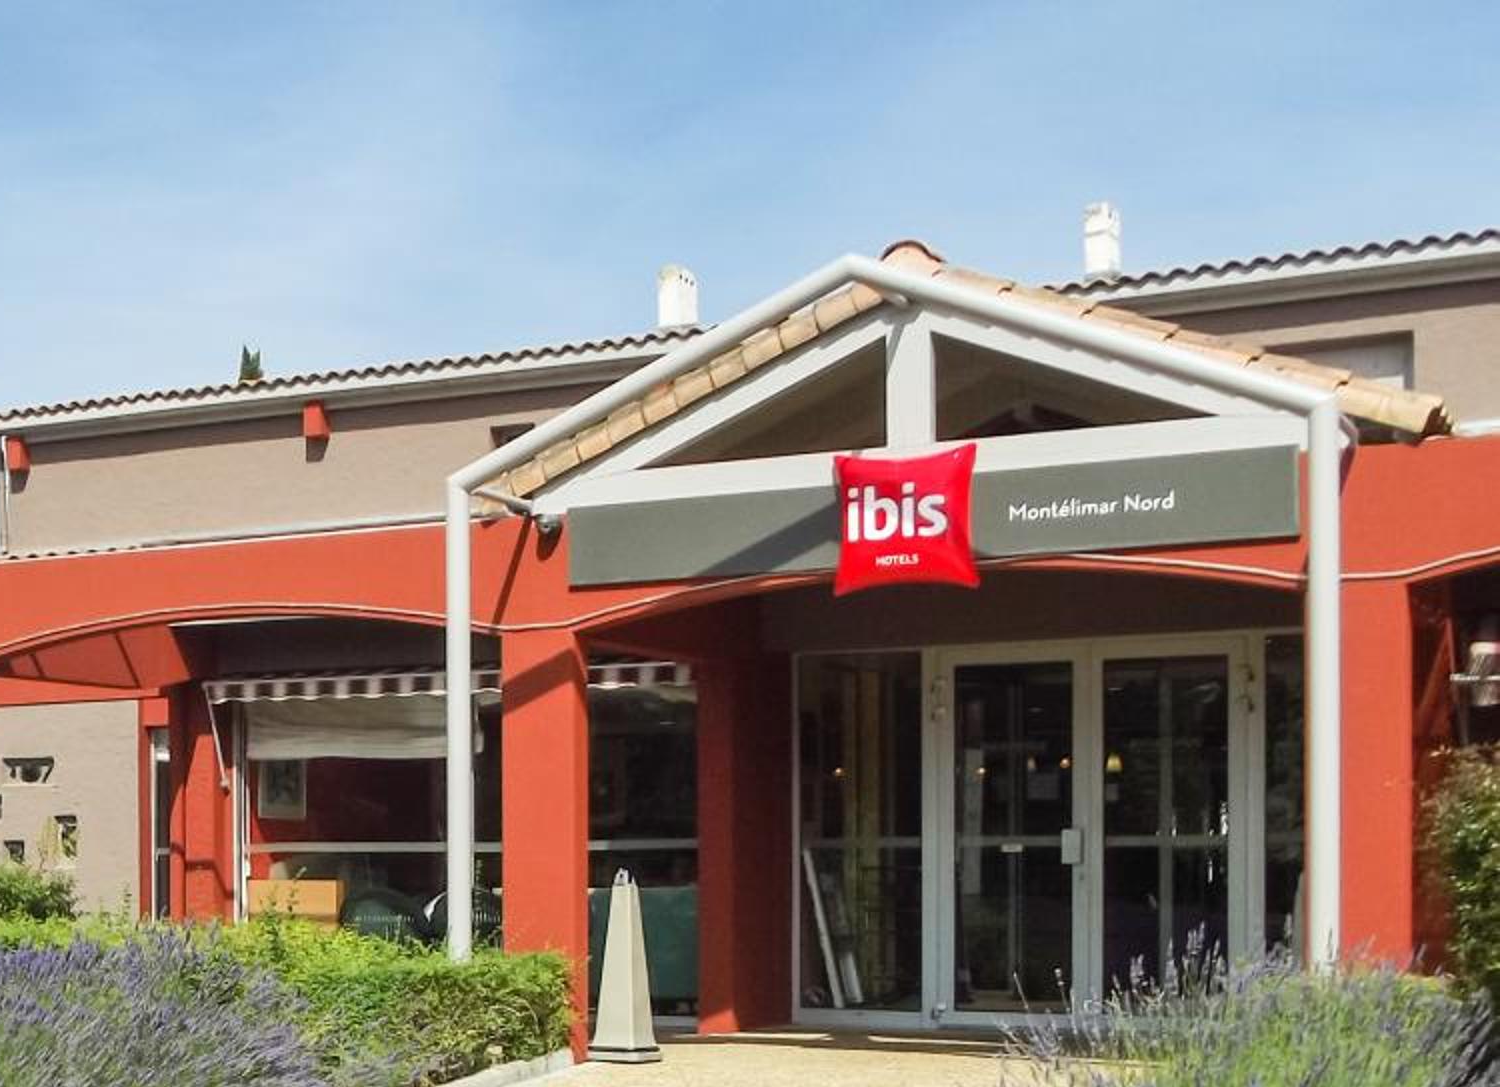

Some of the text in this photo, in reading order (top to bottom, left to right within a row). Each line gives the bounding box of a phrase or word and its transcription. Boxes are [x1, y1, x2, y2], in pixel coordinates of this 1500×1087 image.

[847, 481, 948, 542] ibis
[1009, 490, 1175, 522] Montélimar Nord
[875, 553, 919, 567] HOTELS
